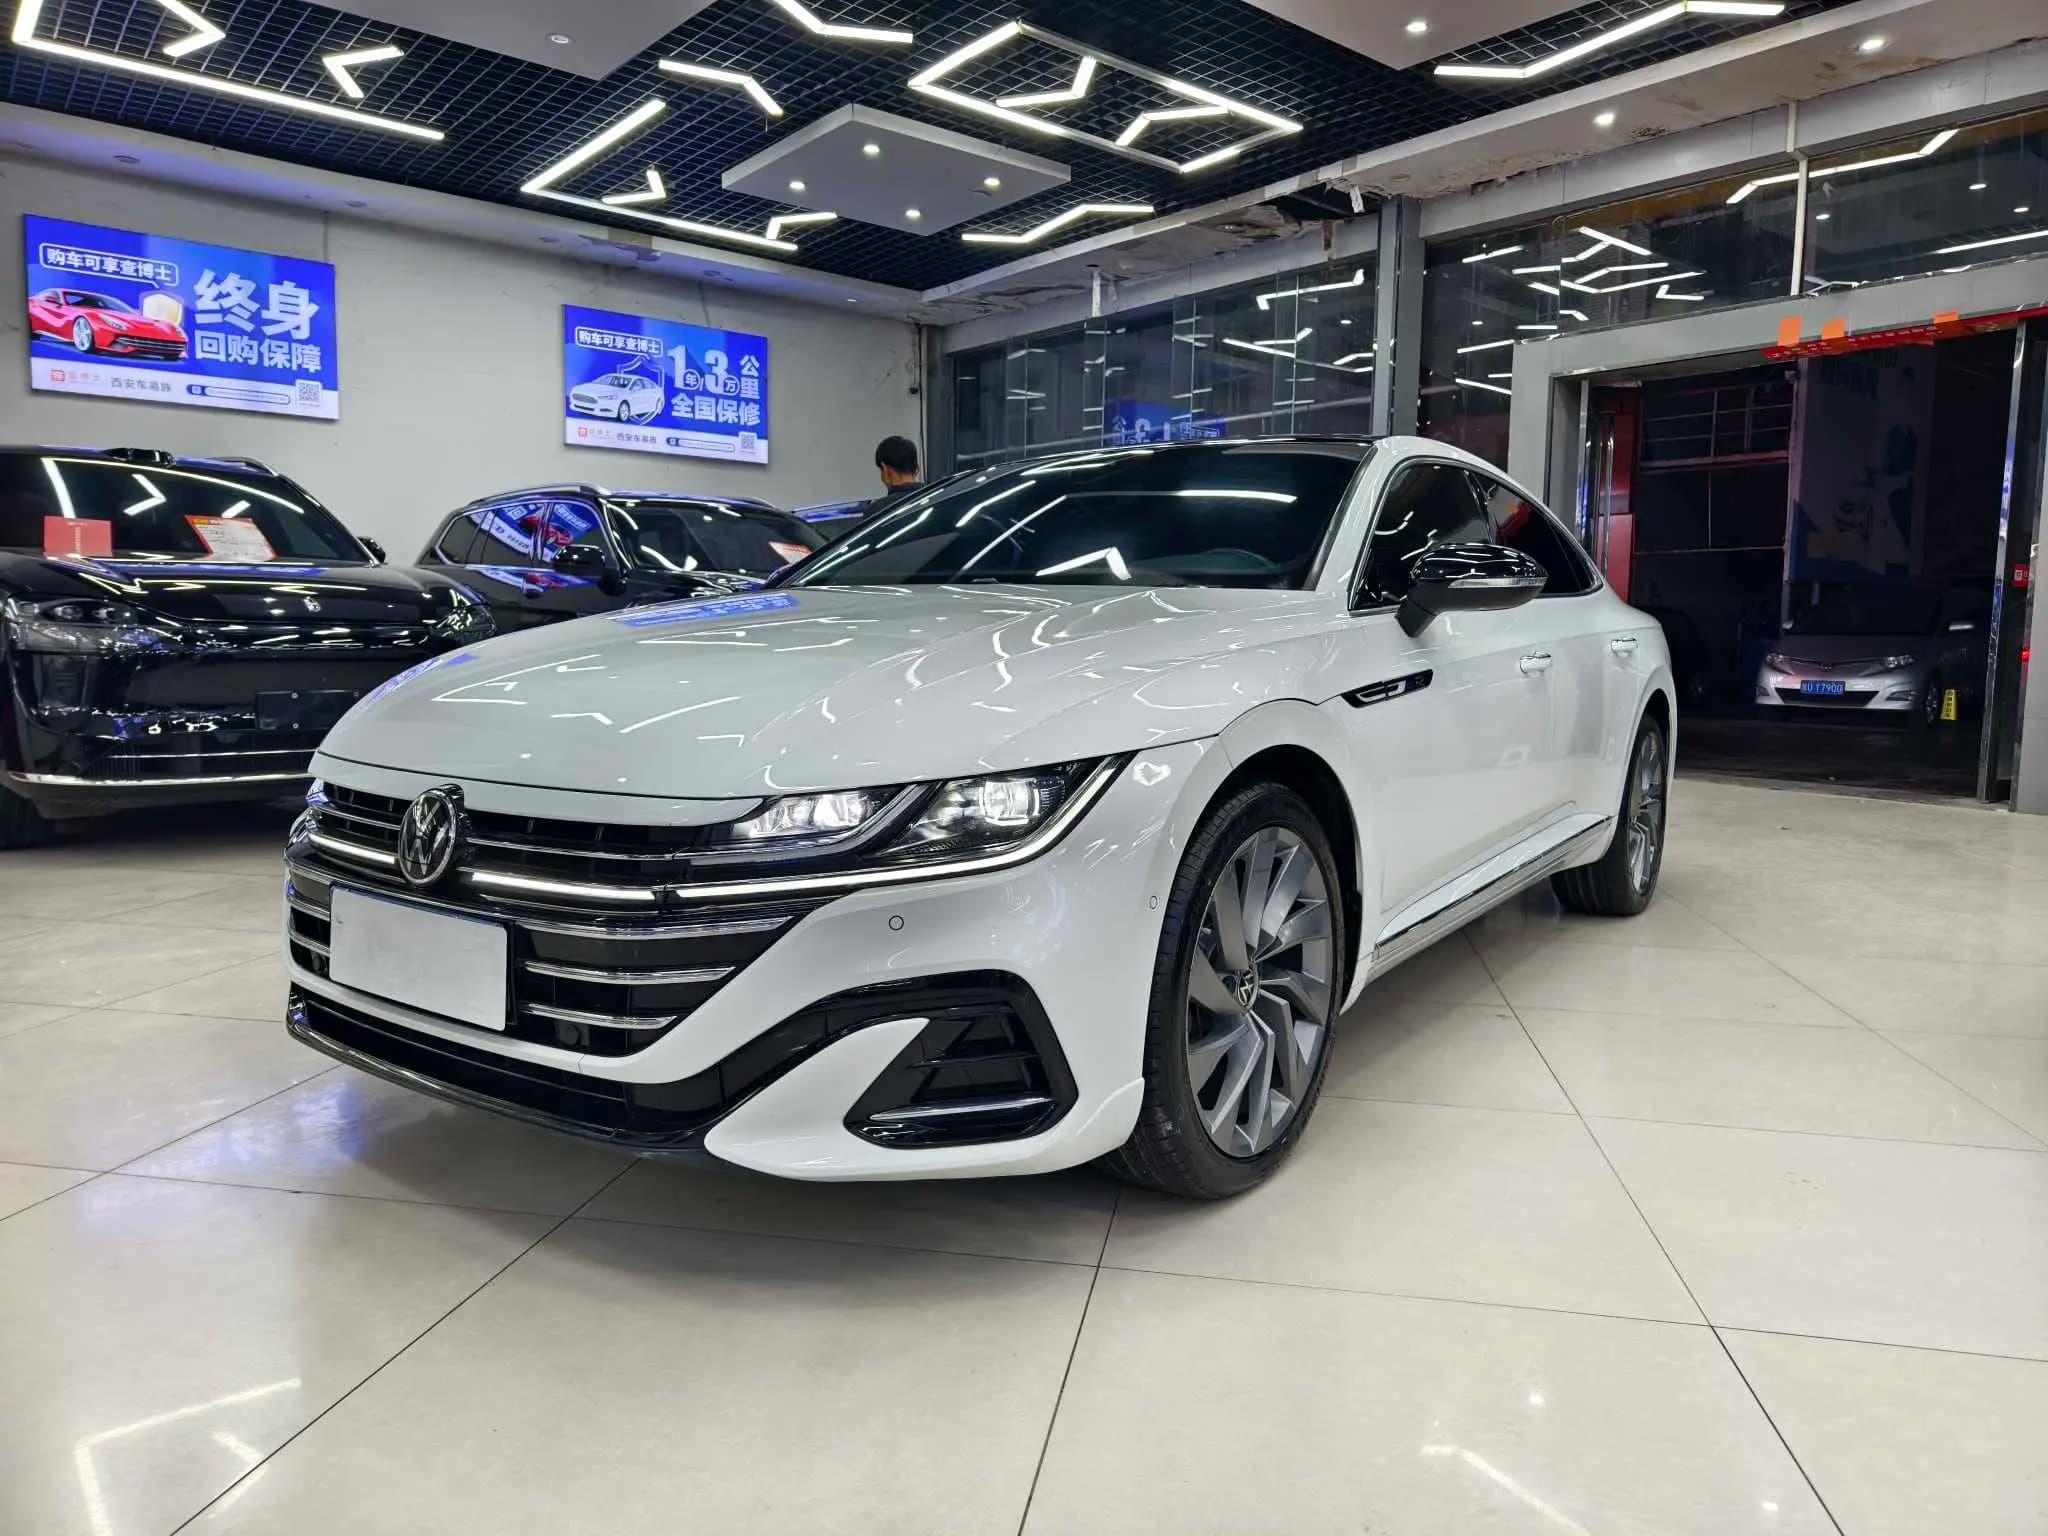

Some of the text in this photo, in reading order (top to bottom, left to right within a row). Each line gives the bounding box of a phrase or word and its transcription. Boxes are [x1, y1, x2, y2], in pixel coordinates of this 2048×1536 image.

[46, 248, 174, 282] 购车可享查博士
[194, 268, 319, 340] 终身
[195, 330, 322, 373] 回购保障
[578, 331, 660, 354] 购车可享查博士
[671, 393, 760, 426] 全国保修
